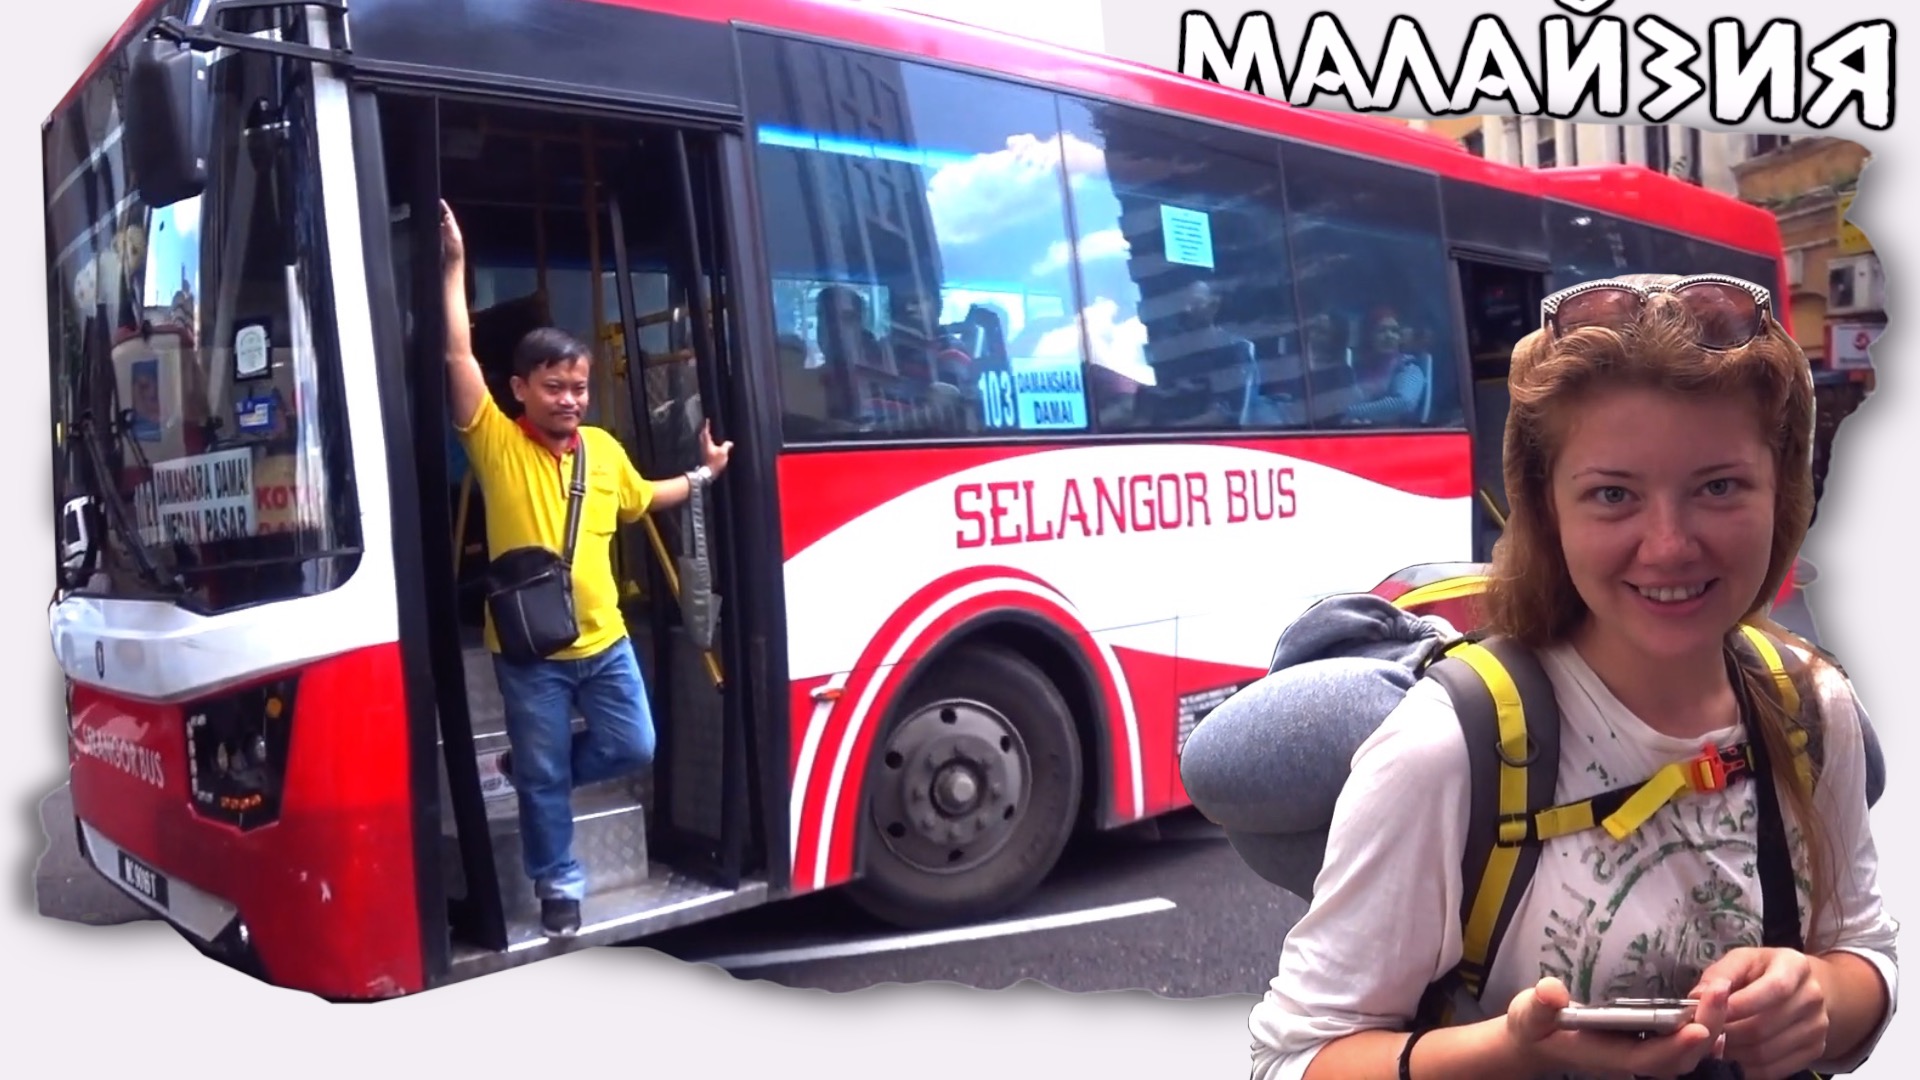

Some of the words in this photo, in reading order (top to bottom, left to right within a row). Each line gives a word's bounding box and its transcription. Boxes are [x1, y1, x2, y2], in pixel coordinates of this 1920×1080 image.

[978, 370, 1015, 428] 103
[1018, 371, 1081, 394] DAMANSARA
[1033, 400, 1075, 425] DAMAI
[213, 457, 250, 499] DAMAI
[204, 504, 249, 541] PASAR
[954, 471, 1211, 549] SELANGOR
[1224, 467, 1296, 524] BUS
[138, 746, 165, 789] BUS
